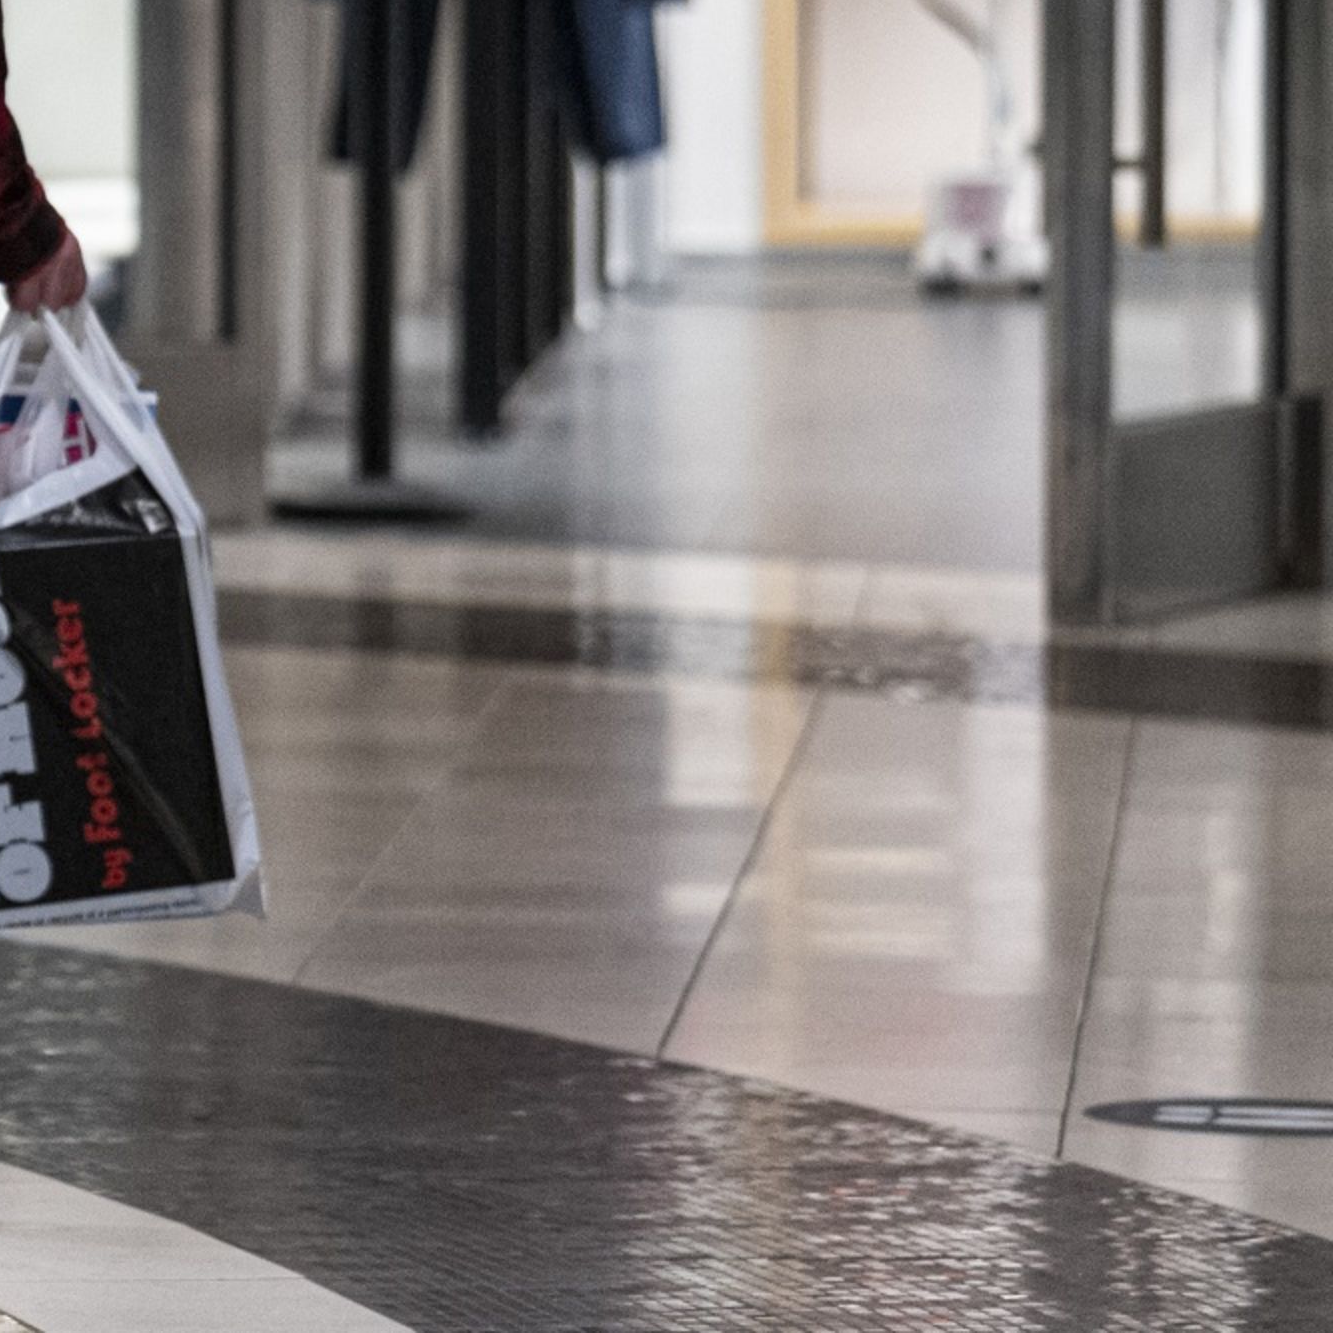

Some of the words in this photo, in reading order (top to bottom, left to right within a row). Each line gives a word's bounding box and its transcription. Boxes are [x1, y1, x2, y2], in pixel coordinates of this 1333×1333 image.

[52, 598, 103, 739] Locker
[74, 752, 122, 841] Foot
[101, 847, 133, 889] by
